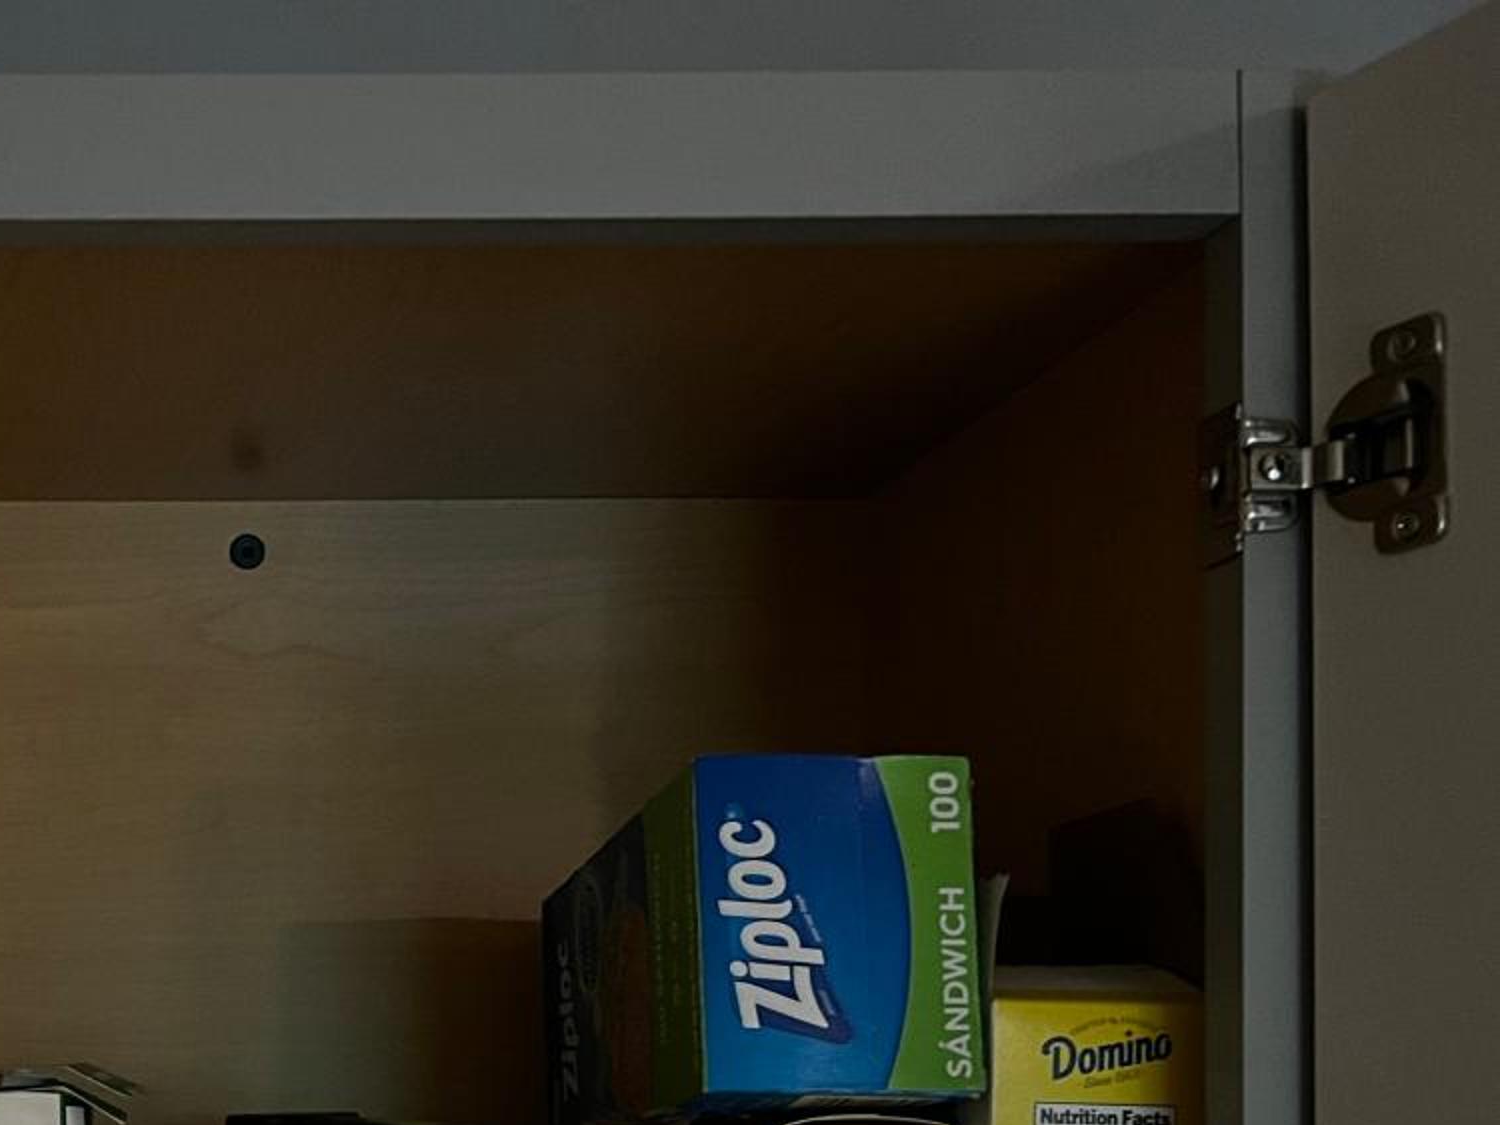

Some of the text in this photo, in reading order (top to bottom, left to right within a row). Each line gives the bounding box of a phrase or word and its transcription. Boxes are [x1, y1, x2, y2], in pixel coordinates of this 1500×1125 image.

[928, 771, 962, 833] 100
[718, 818, 830, 1030] Ziploc
[1041, 1030, 1173, 1080] Domino
